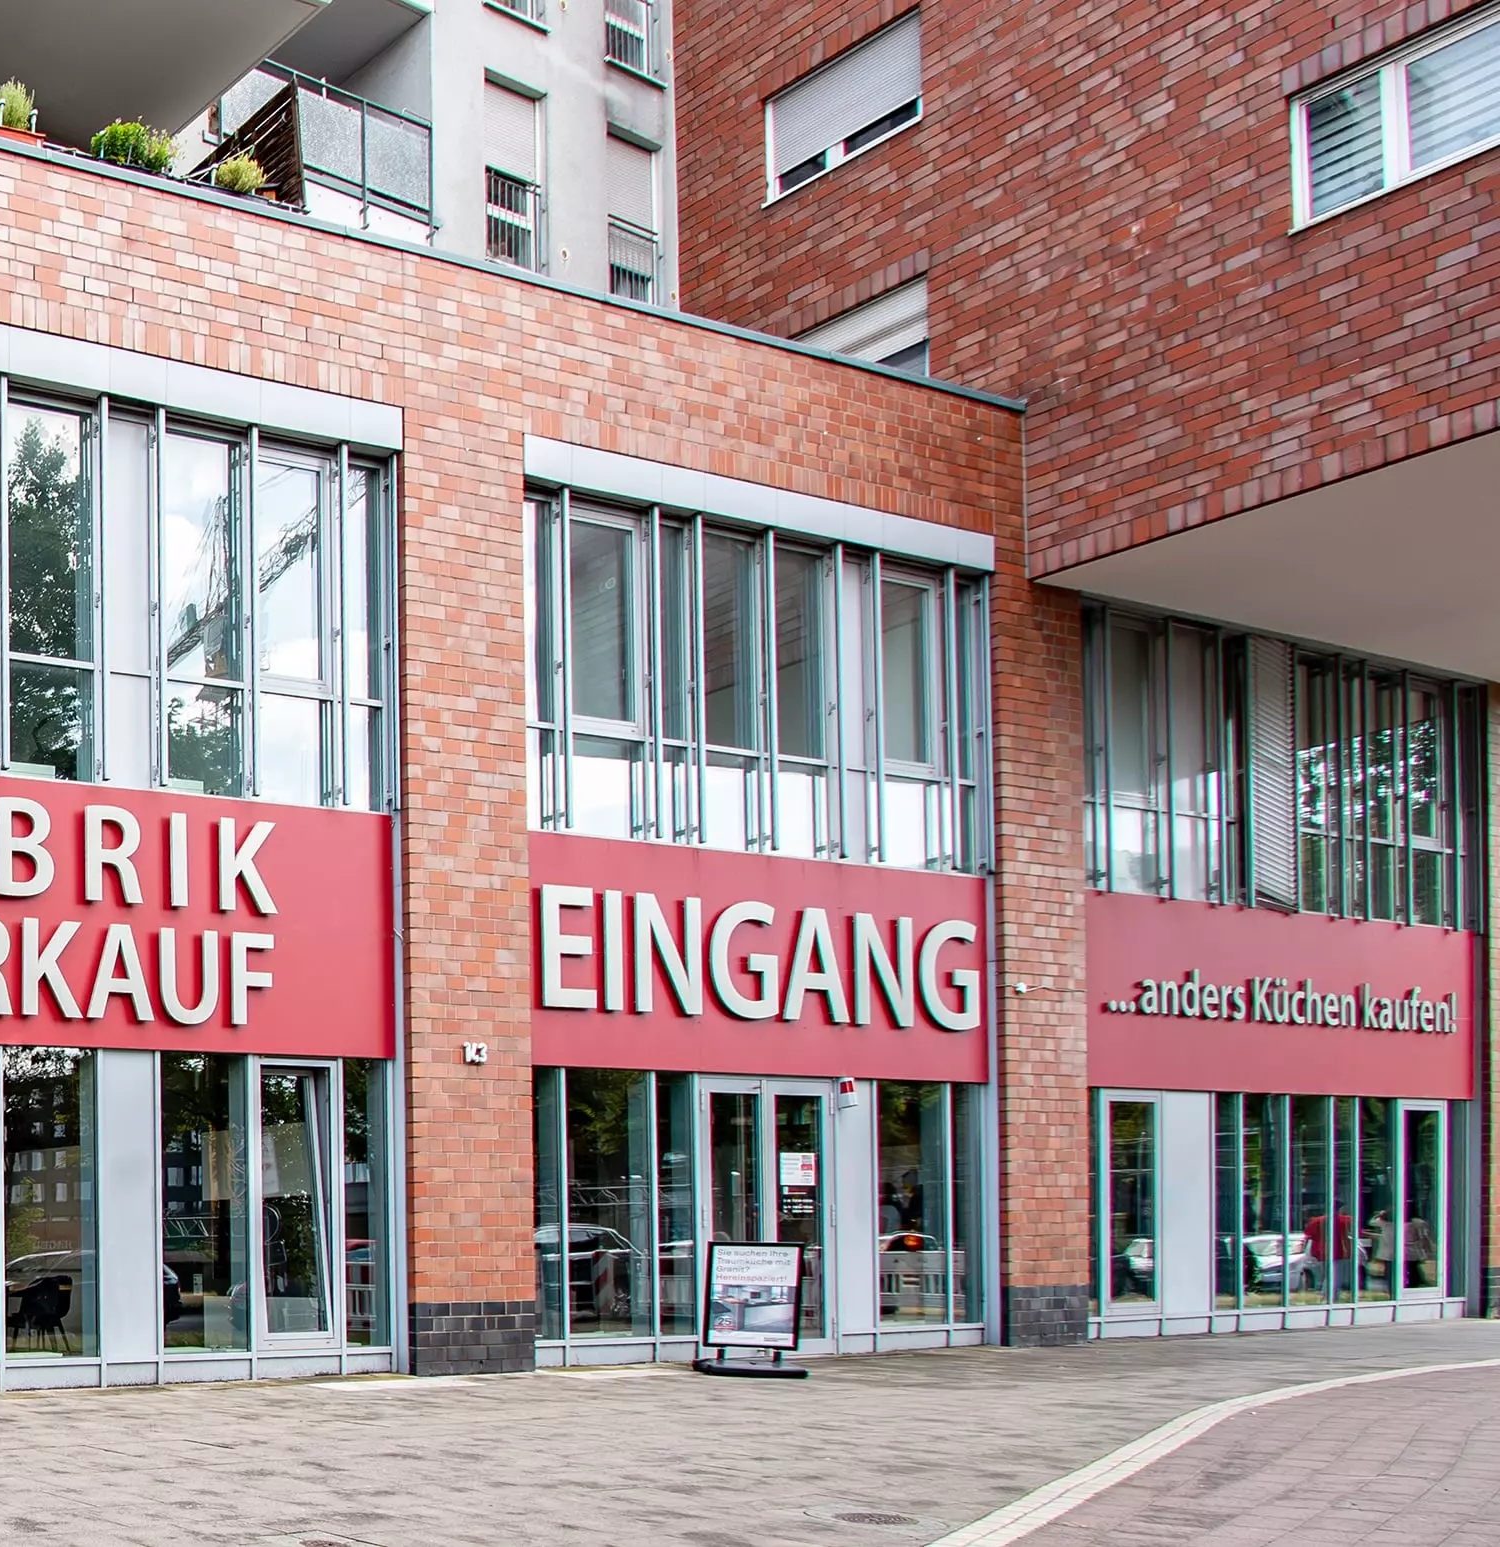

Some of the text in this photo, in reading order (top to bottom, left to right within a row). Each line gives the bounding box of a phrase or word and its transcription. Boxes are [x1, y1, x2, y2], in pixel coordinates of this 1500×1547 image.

[540, 883, 982, 1032] EINGANG
[1106, 968, 1458, 1035] ...anders Küchen kaufen!
[463, 1041, 488, 1064] 143
[717, 1248, 732, 1256] Sie
[733, 1249, 768, 1257] suchen
[717, 1317, 732, 1326] 25
